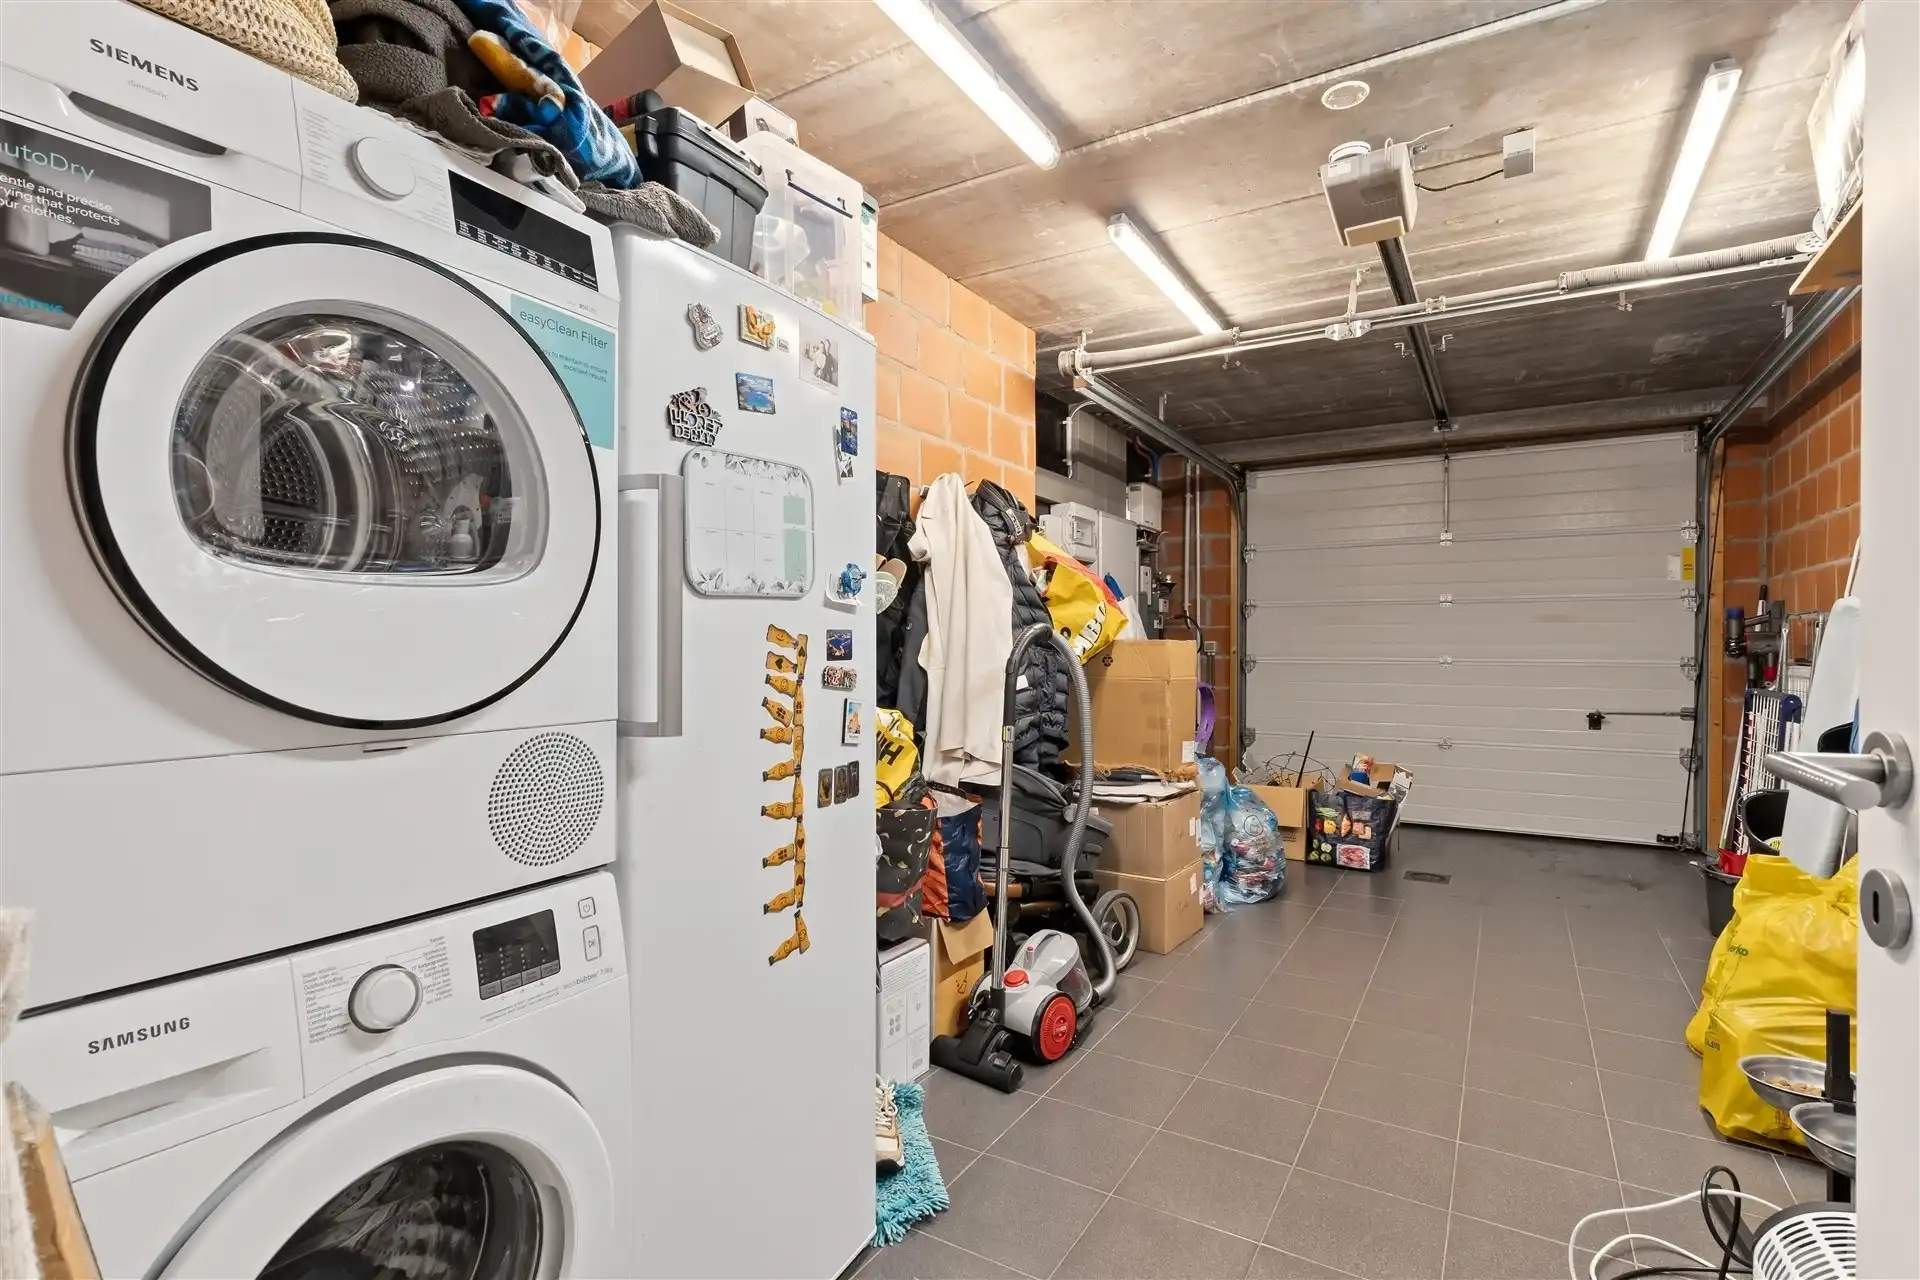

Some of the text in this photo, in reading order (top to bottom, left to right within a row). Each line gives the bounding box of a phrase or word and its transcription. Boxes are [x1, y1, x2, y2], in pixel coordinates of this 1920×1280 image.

[90, 38, 200, 92] SIEMENS
[0, 173, 113, 214] entle and precise
[36, 195, 64, 210] that
[66, 205, 121, 226] protects
[22, 204, 75, 226] clothes.
[519, 310, 609, 350] easyClean Filter
[671, 407, 725, 435] LLORET
[87, 1016, 191, 1055] SAMSUNG
